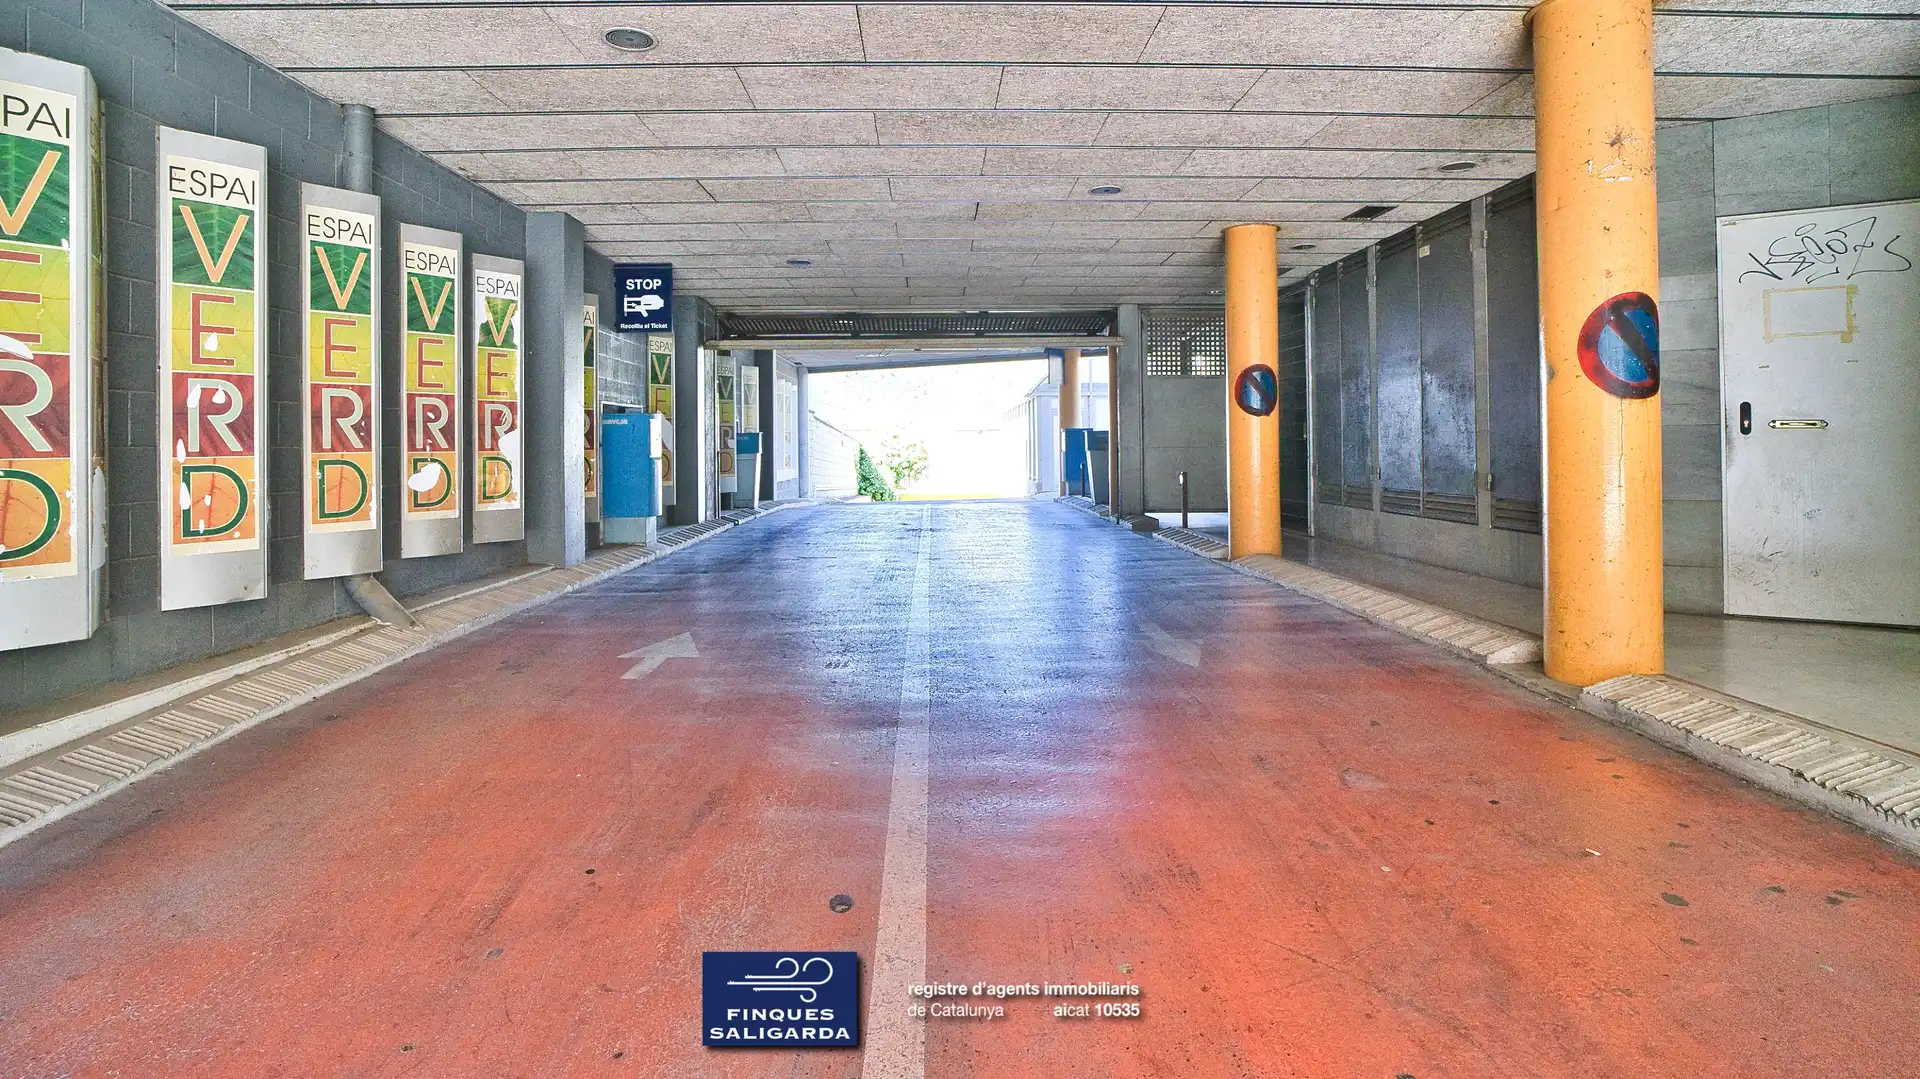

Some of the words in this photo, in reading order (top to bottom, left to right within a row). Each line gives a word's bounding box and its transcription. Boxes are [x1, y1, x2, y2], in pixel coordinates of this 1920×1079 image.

[168, 165, 255, 206] ESPAI
[306, 213, 372, 245] ESPAI
[404, 249, 456, 275] ESPAI
[476, 276, 519, 298] ESPAI
[625, 279, 662, 290] STOP
[178, 205, 250, 538] VERD
[314, 246, 369, 520] VERD
